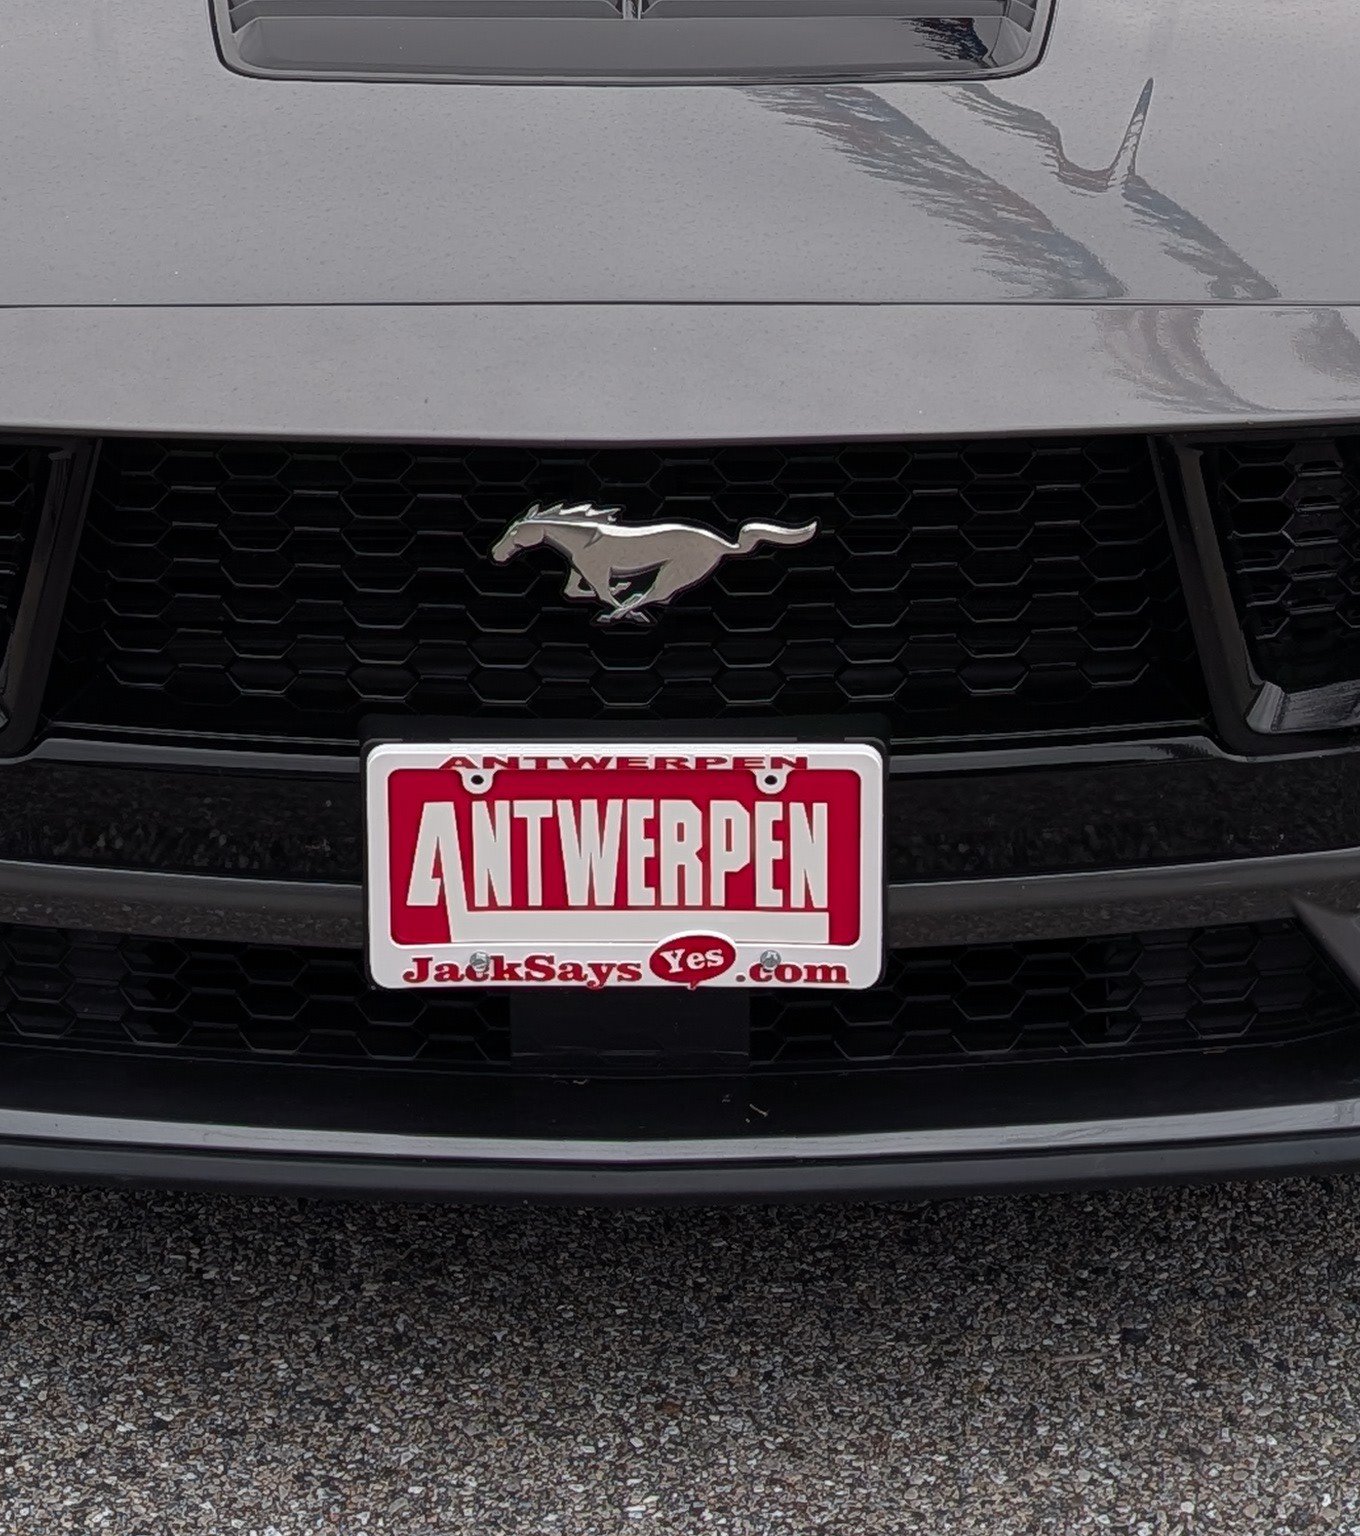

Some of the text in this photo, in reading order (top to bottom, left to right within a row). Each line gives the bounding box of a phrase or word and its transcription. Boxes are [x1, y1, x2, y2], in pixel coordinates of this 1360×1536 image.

[439, 754, 809, 771] ANTWERPEN
[405, 798, 830, 943] ANTWERPEN
[660, 948, 725, 974] Yes
